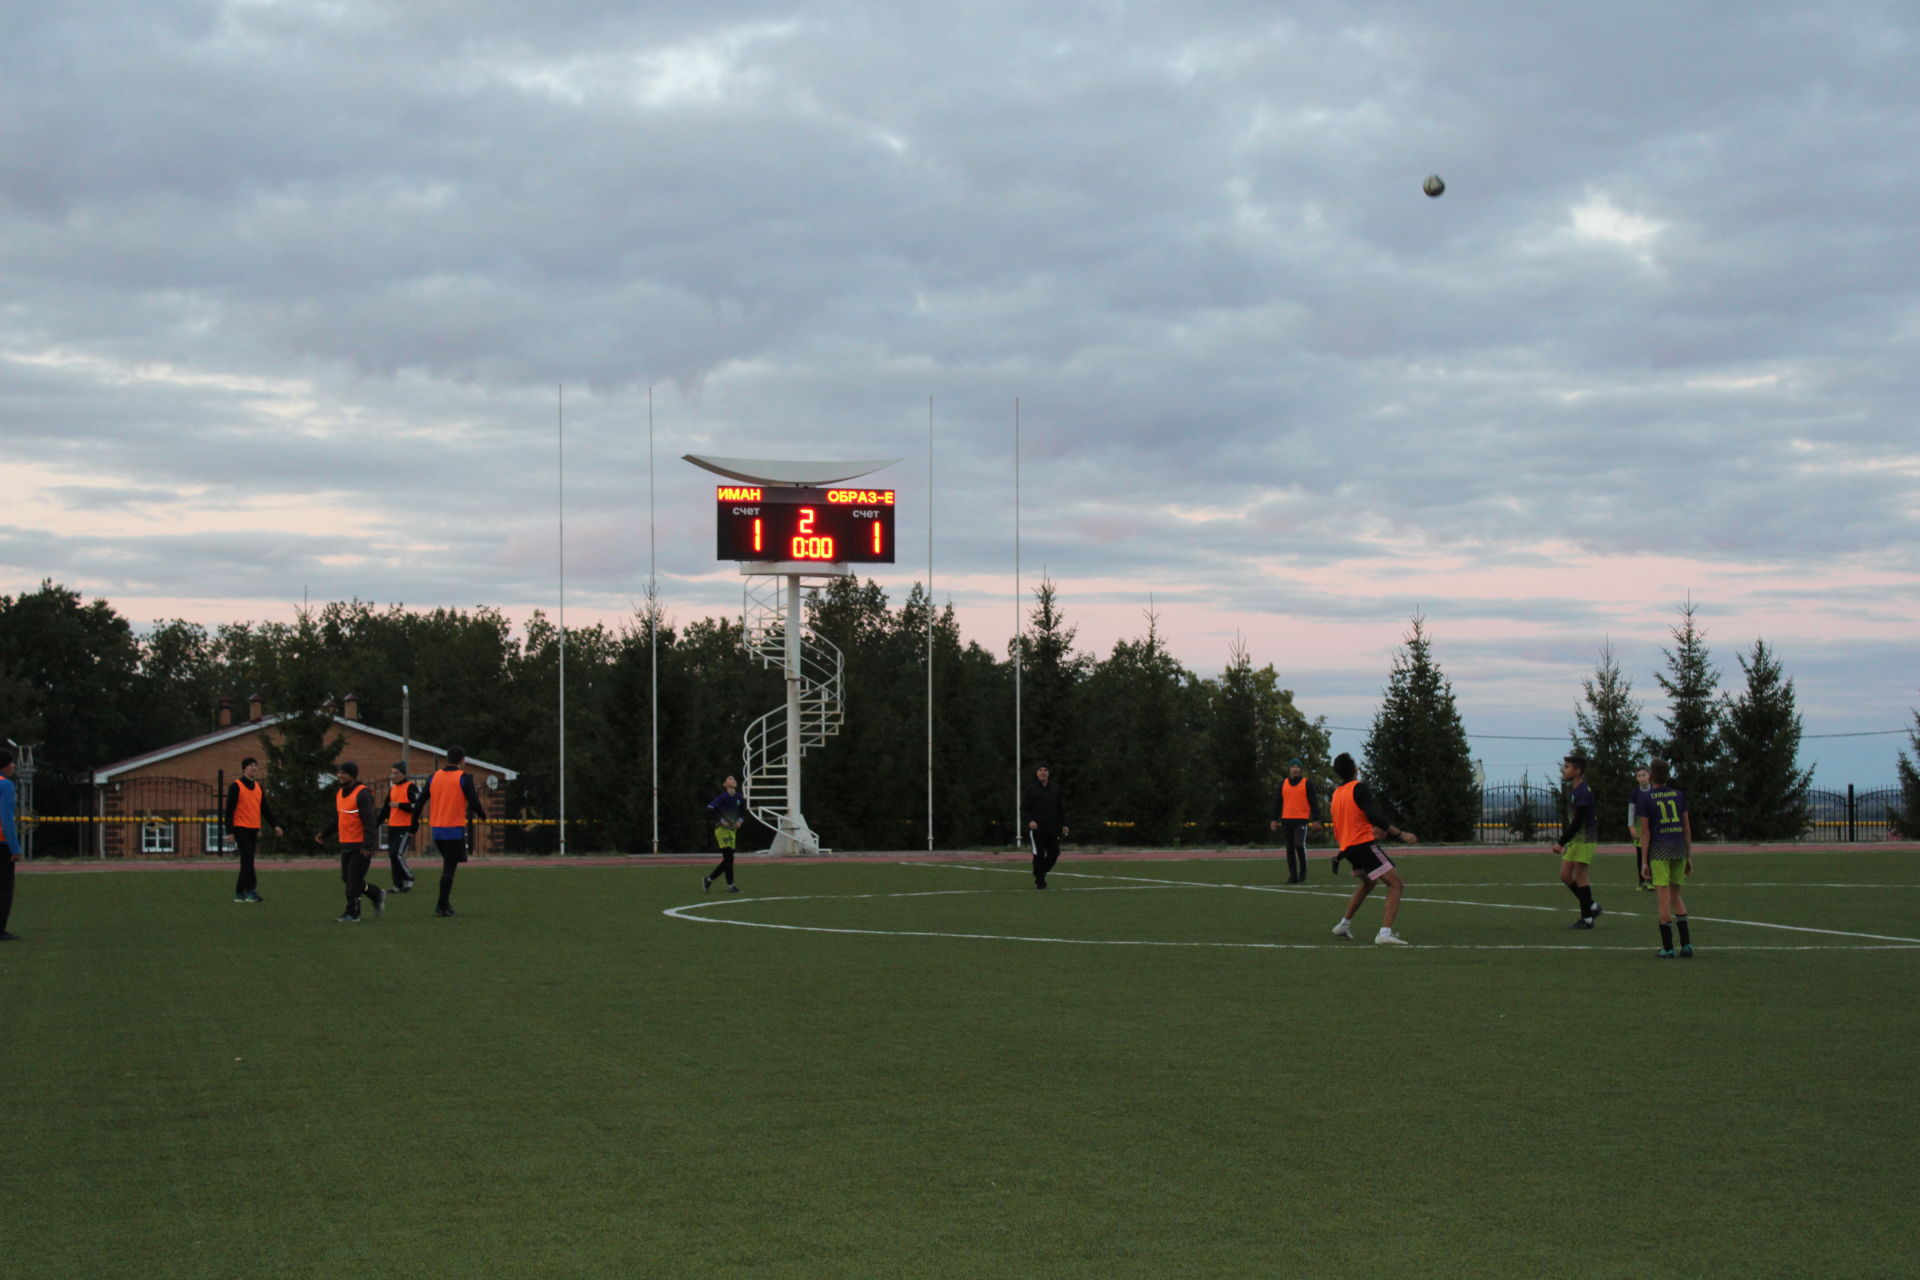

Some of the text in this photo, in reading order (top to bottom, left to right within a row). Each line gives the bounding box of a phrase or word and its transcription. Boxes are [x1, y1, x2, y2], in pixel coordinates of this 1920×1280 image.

[717, 487, 761, 501] ИМАН
[827, 490, 895, 505] ОБРАЗ-Е
[798, 508, 816, 534] 2
[754, 519, 762, 552] 1
[791, 536, 833, 559] 0:00
[873, 521, 882, 554] 1
[1656, 799, 1680, 824] 11
